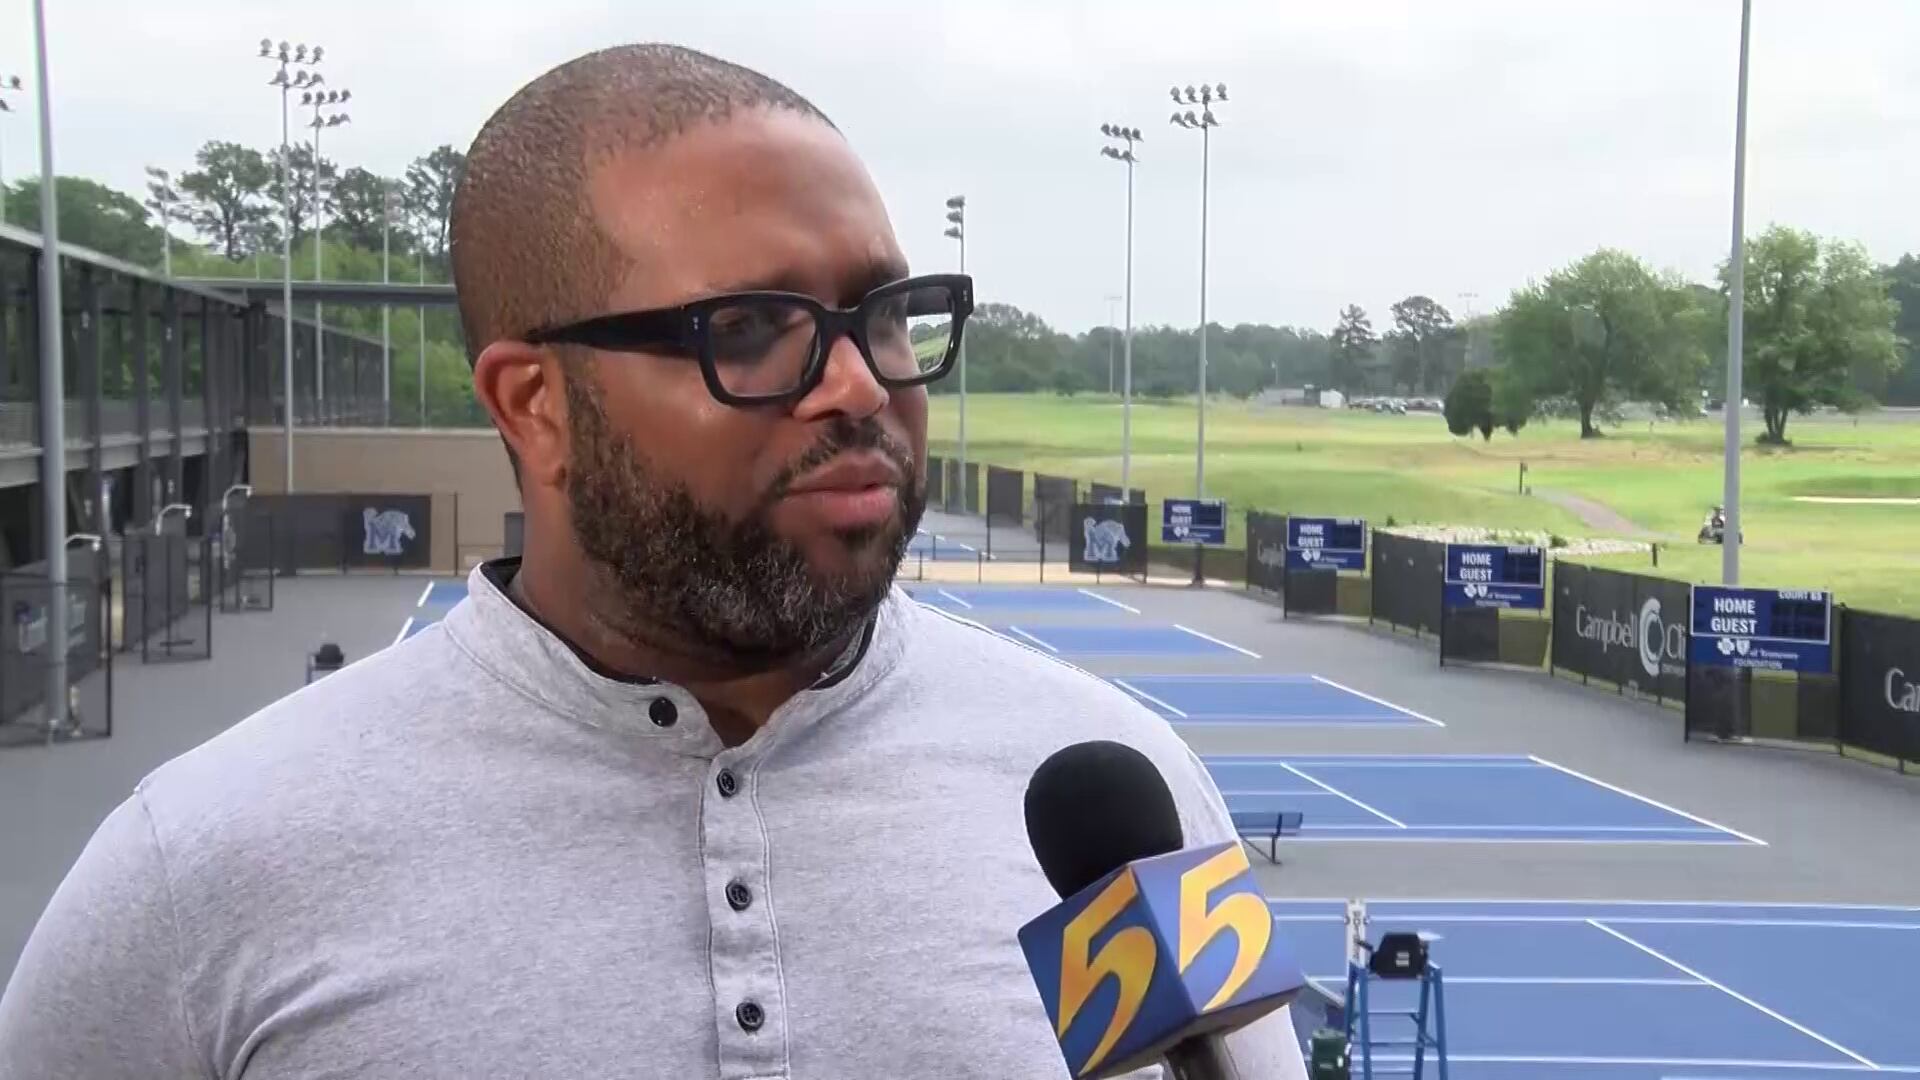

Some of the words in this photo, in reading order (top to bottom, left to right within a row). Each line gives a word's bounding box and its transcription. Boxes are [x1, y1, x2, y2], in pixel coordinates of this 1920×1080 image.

[1300, 525, 1324, 535] HOME
[1298, 537, 1324, 548] GUEST
[1462, 552, 1491, 565] HOME
[1460, 568, 1492, 581] GUEST
[1713, 598, 1756, 615] HOME
[1576, 604, 1637, 653] Campbell
[1711, 617, 1757, 634] GUEST
[1178, 844, 1272, 1012] 5
[1057, 866, 1157, 1078] 5
